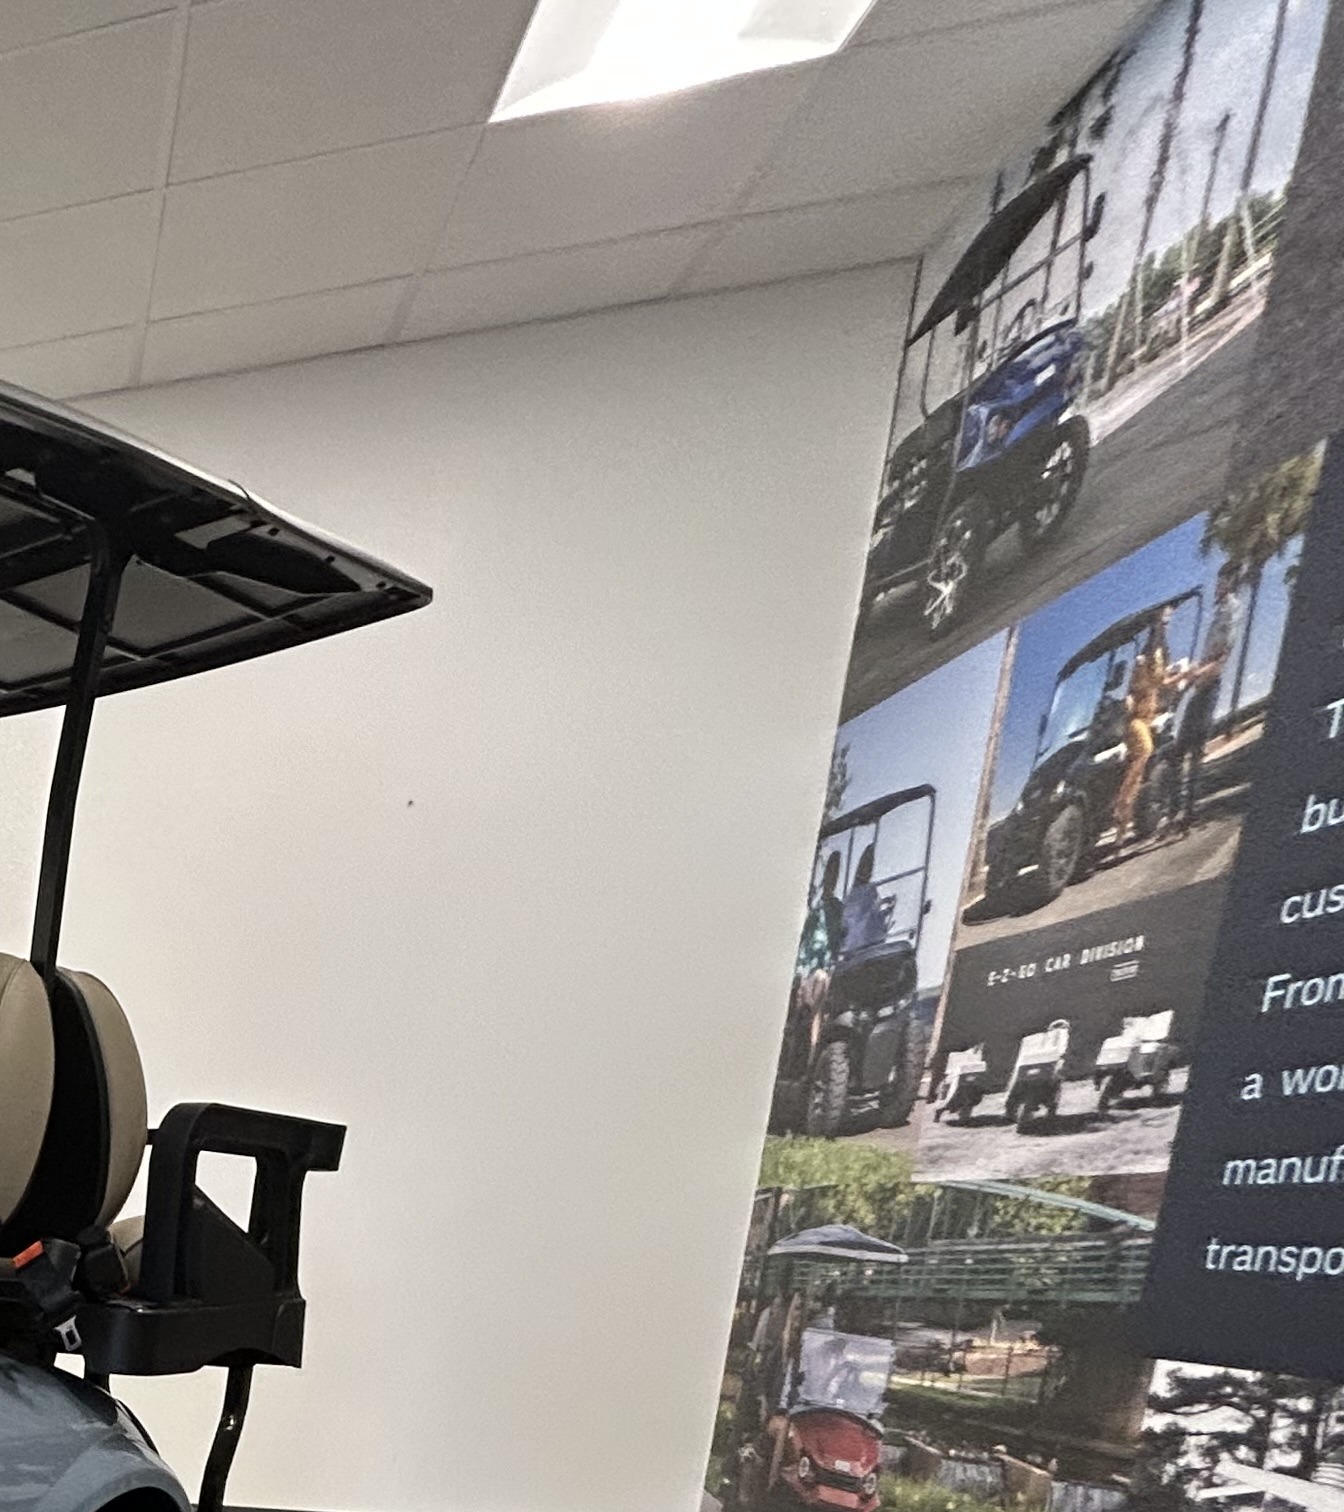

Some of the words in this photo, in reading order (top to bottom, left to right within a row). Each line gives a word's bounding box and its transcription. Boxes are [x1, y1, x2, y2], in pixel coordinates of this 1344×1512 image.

[1280, 884, 1344, 923] cus
[1239, 1072, 1264, 1101] a
[1204, 1237, 1344, 1282] transpo
